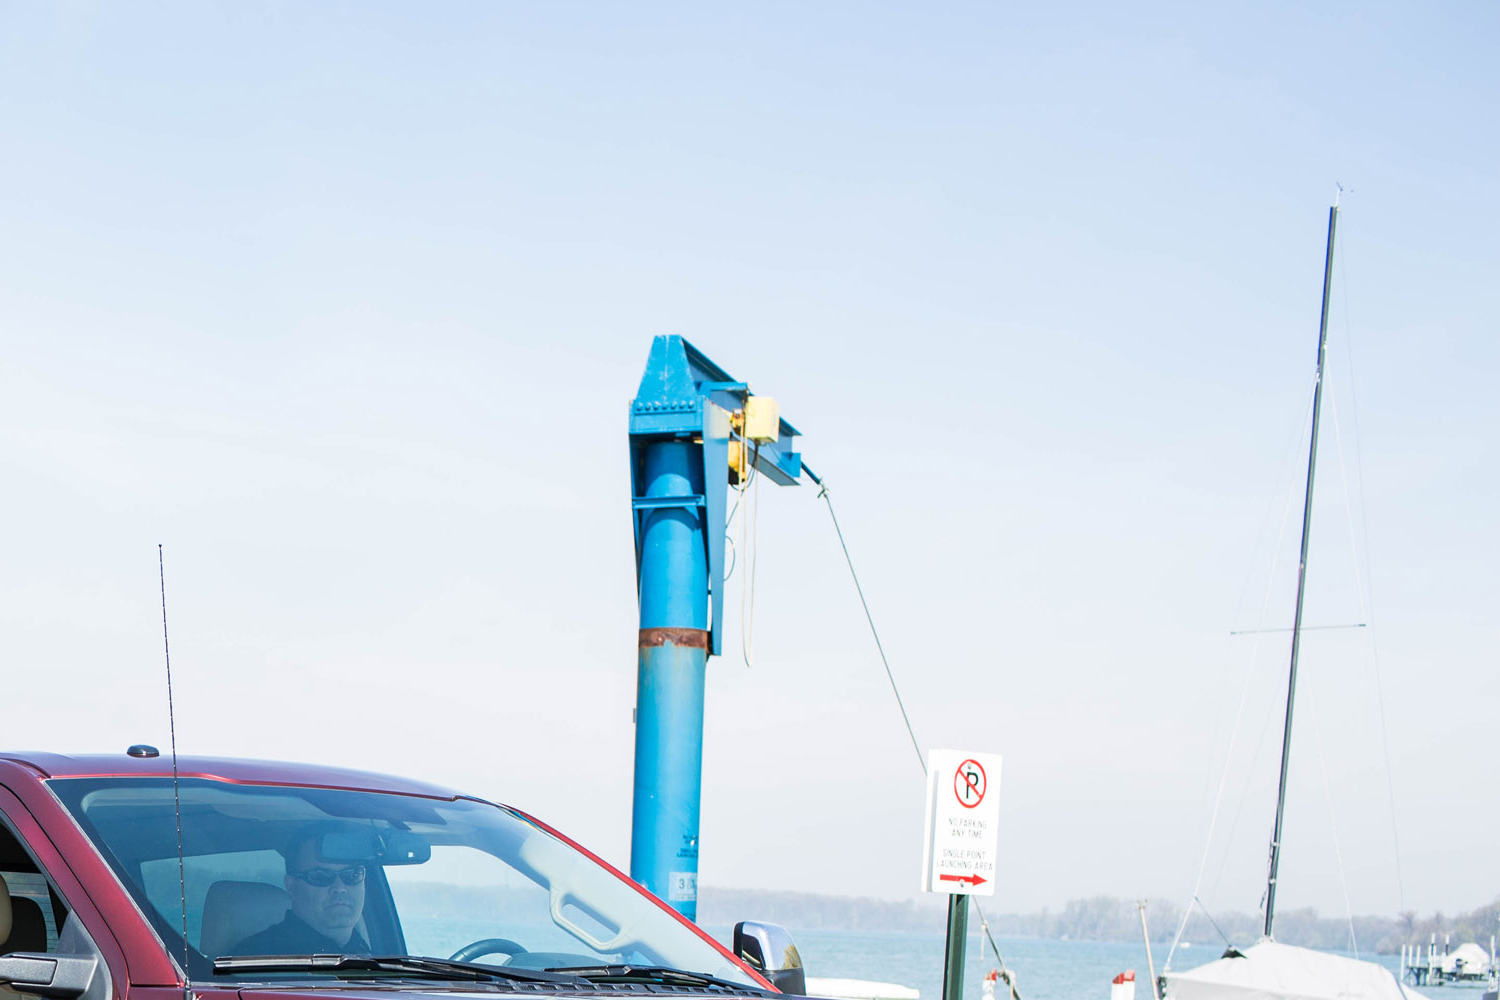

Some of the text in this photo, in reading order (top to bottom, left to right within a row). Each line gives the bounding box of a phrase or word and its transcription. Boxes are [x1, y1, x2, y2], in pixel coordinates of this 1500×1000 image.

[949, 818, 987, 829] NO PARKING
[952, 829, 982, 839] ANY TIME
[943, 849, 986, 860] SINGLE POINT
[937, 858, 993, 871] LAUNCHING AREA
